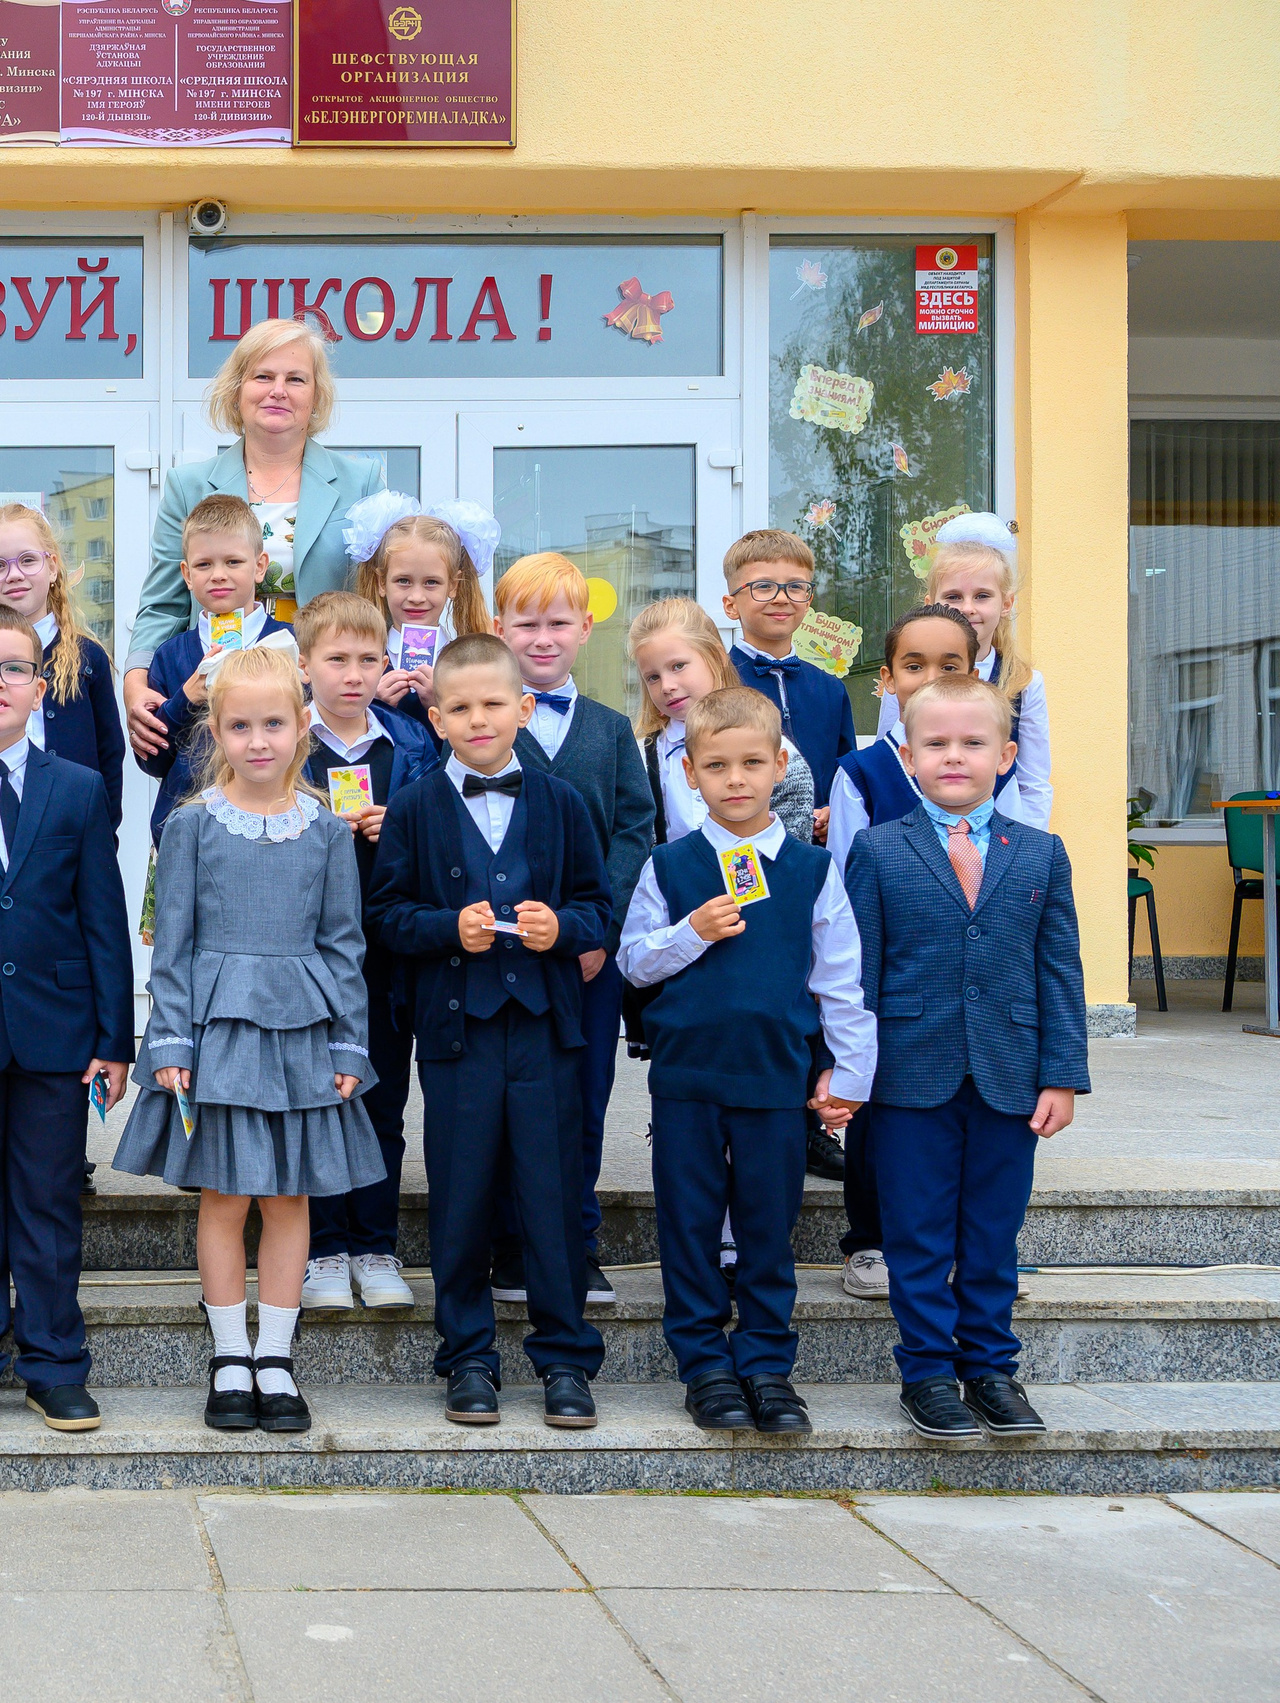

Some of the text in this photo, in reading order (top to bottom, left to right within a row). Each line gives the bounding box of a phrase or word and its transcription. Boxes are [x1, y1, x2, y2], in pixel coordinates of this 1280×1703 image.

[89, 43, 147, 52] ДЗЯРЖАЎНАЯ
[196, 45, 276, 53] ГОСУДАРСТВЕННОЕ
[207, 54, 265, 62] УЧРЕЖДЕНИЕ
[331, 53, 479, 67] ШЕФСТВУЮЩАЯ
[96, 60, 142, 69] АДУКАЦЫІ
[206, 61, 266, 70] ОБРАЗОВАНИЯ
[6, 66, 56, 77] Минска
[62, 77, 173, 86] «СЯРЭДНЯЯ ШКОЛА
[180, 77, 288, 86] «СРЕДНЯЯ ШКОЛА
[341, 71, 470, 85] ОРГАНИЗАЦИЯ
[118, 89, 164, 98] МІНСКА
[231, 89, 282, 98] МИНСКА
[312, 95, 498, 103] ОТКРЫТОЕ АКЦИОНЕРНОЕ ОБЩЕСТВО
[87, 100, 146, 109] ІМЯ ГЕРОЯЎ
[195, 101, 271, 109] ИМЕНИ ГЕРОЕВ
[82, 112, 105, 121] 120-Й
[194, 112, 273, 122] 120-Й ДИВИЗИИ»
[303, 110, 507, 126] «БЕЛЭНЕРГОРЕМНАЛАДКА»
[919, 292, 974, 308] ЗДЕСЬ
[918, 321, 975, 332] МИЛИЦИЮ
[810, 369, 865, 394] Вперёд к
[808, 385, 862, 407] знаниям!
[815, 614, 841, 633] Буду
[800, 622, 855, 649] тличником!
